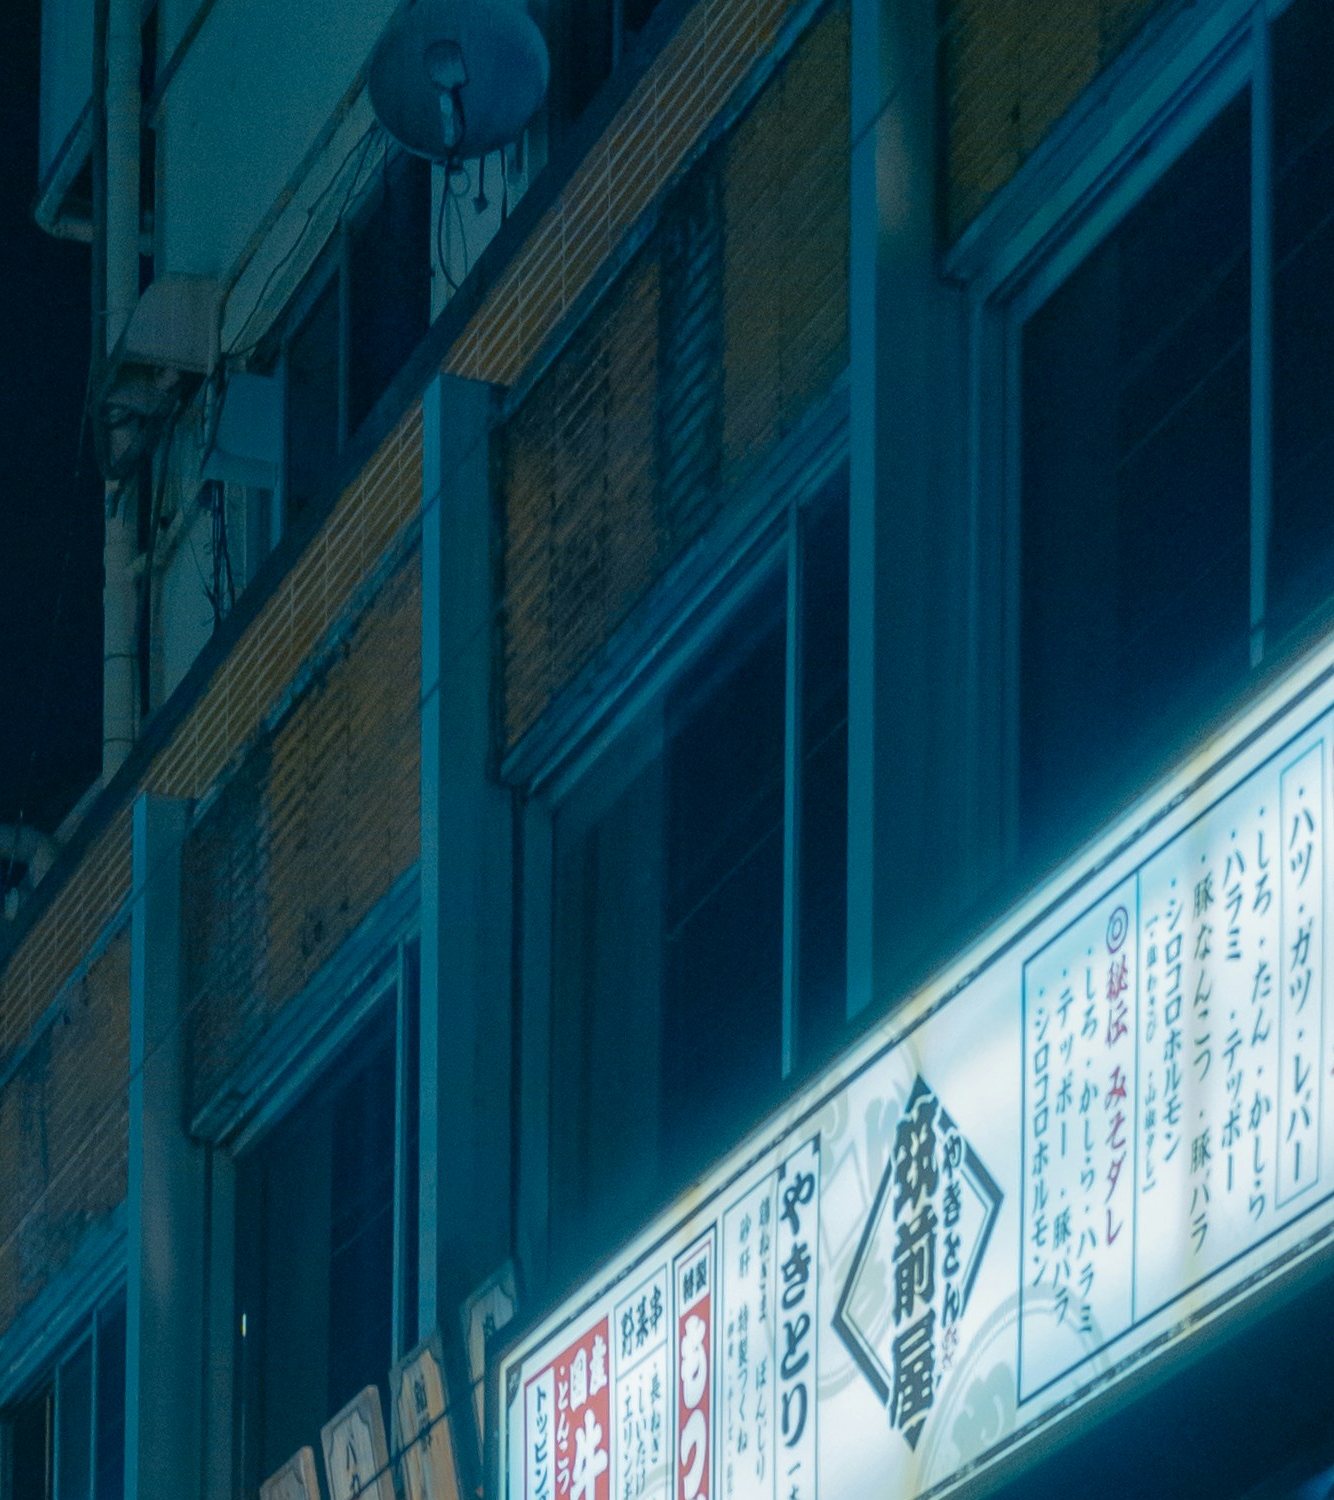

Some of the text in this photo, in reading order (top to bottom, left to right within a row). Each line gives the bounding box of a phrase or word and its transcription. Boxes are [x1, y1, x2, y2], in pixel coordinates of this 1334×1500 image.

[618, 1284, 664, 1369] 野菜串
[779, 1169, 816, 1449] やきとり
[893, 1095, 940, 1432] 筑前屋
[940, 1133, 964, 1329] やきとん
